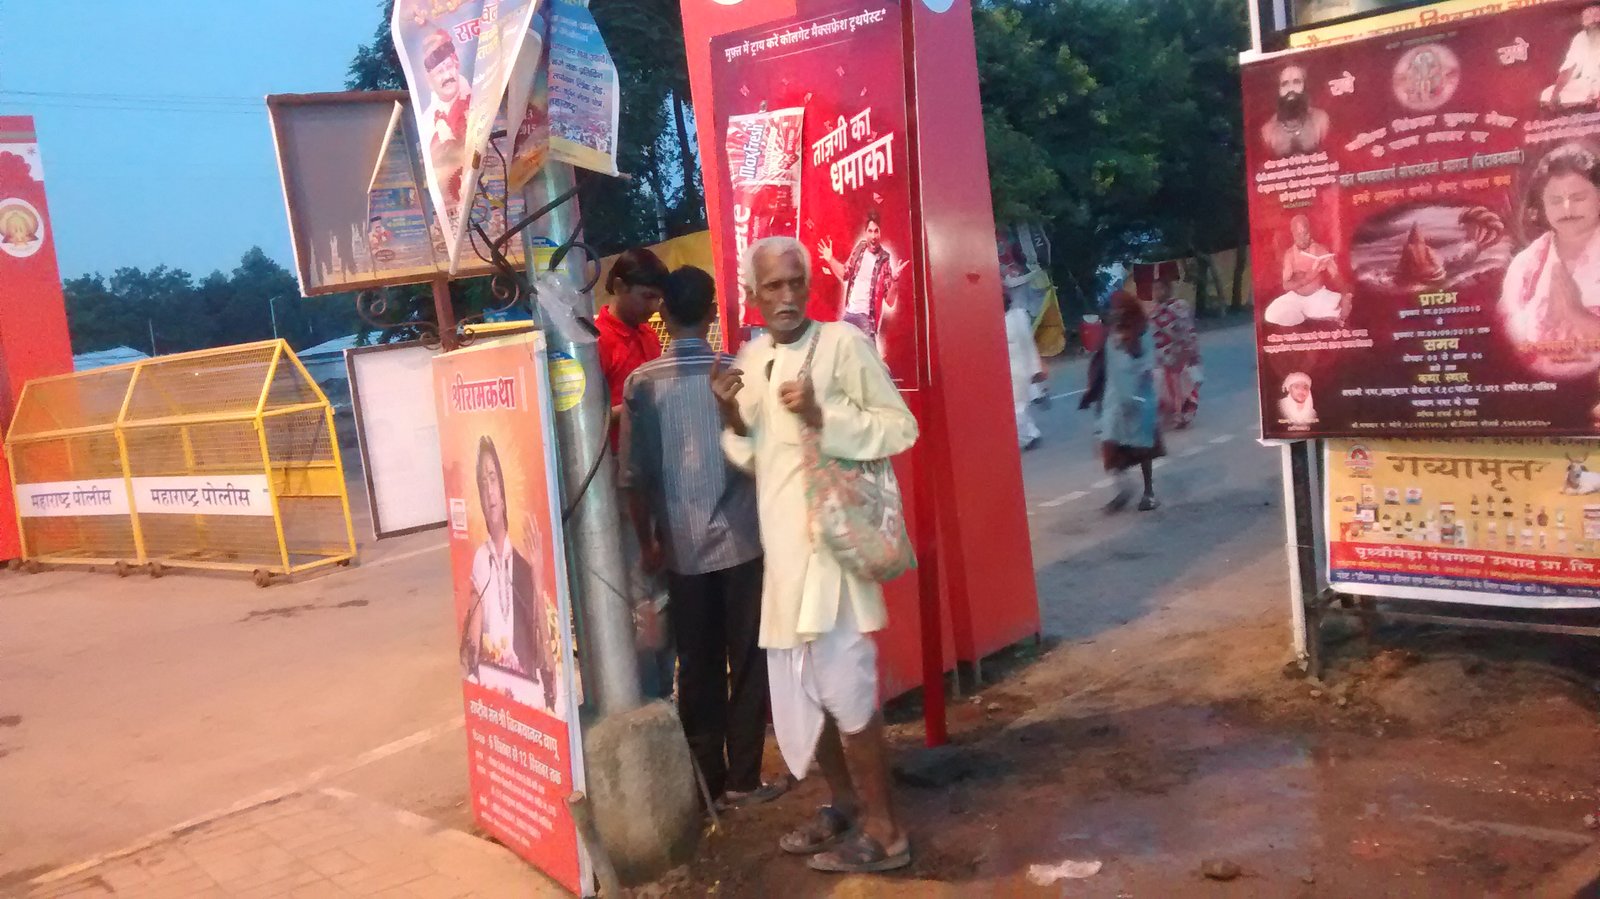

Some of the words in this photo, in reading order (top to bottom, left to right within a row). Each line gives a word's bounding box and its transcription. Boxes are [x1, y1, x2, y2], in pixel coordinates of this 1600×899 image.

[766, 33, 779, 48] करें
[780, 27, 810, 45] कोलगेट
[849, 106, 872, 141] का
[830, 131, 894, 195] धमाका
[1418, 290, 1458, 306] प्रारंभ
[1423, 337, 1460, 351] समय
[452, 372, 515, 412] श्रीरामकथा
[1386, 455, 1551, 493] गव्यामृत
[31, 490, 71, 509] महाराष्ट्र
[73, 485, 111, 506] पोलीस
[150, 488, 200, 508] महाराष्ट्र
[202, 482, 250, 506] पोलीस
[519, 750, 528, 767] 12
